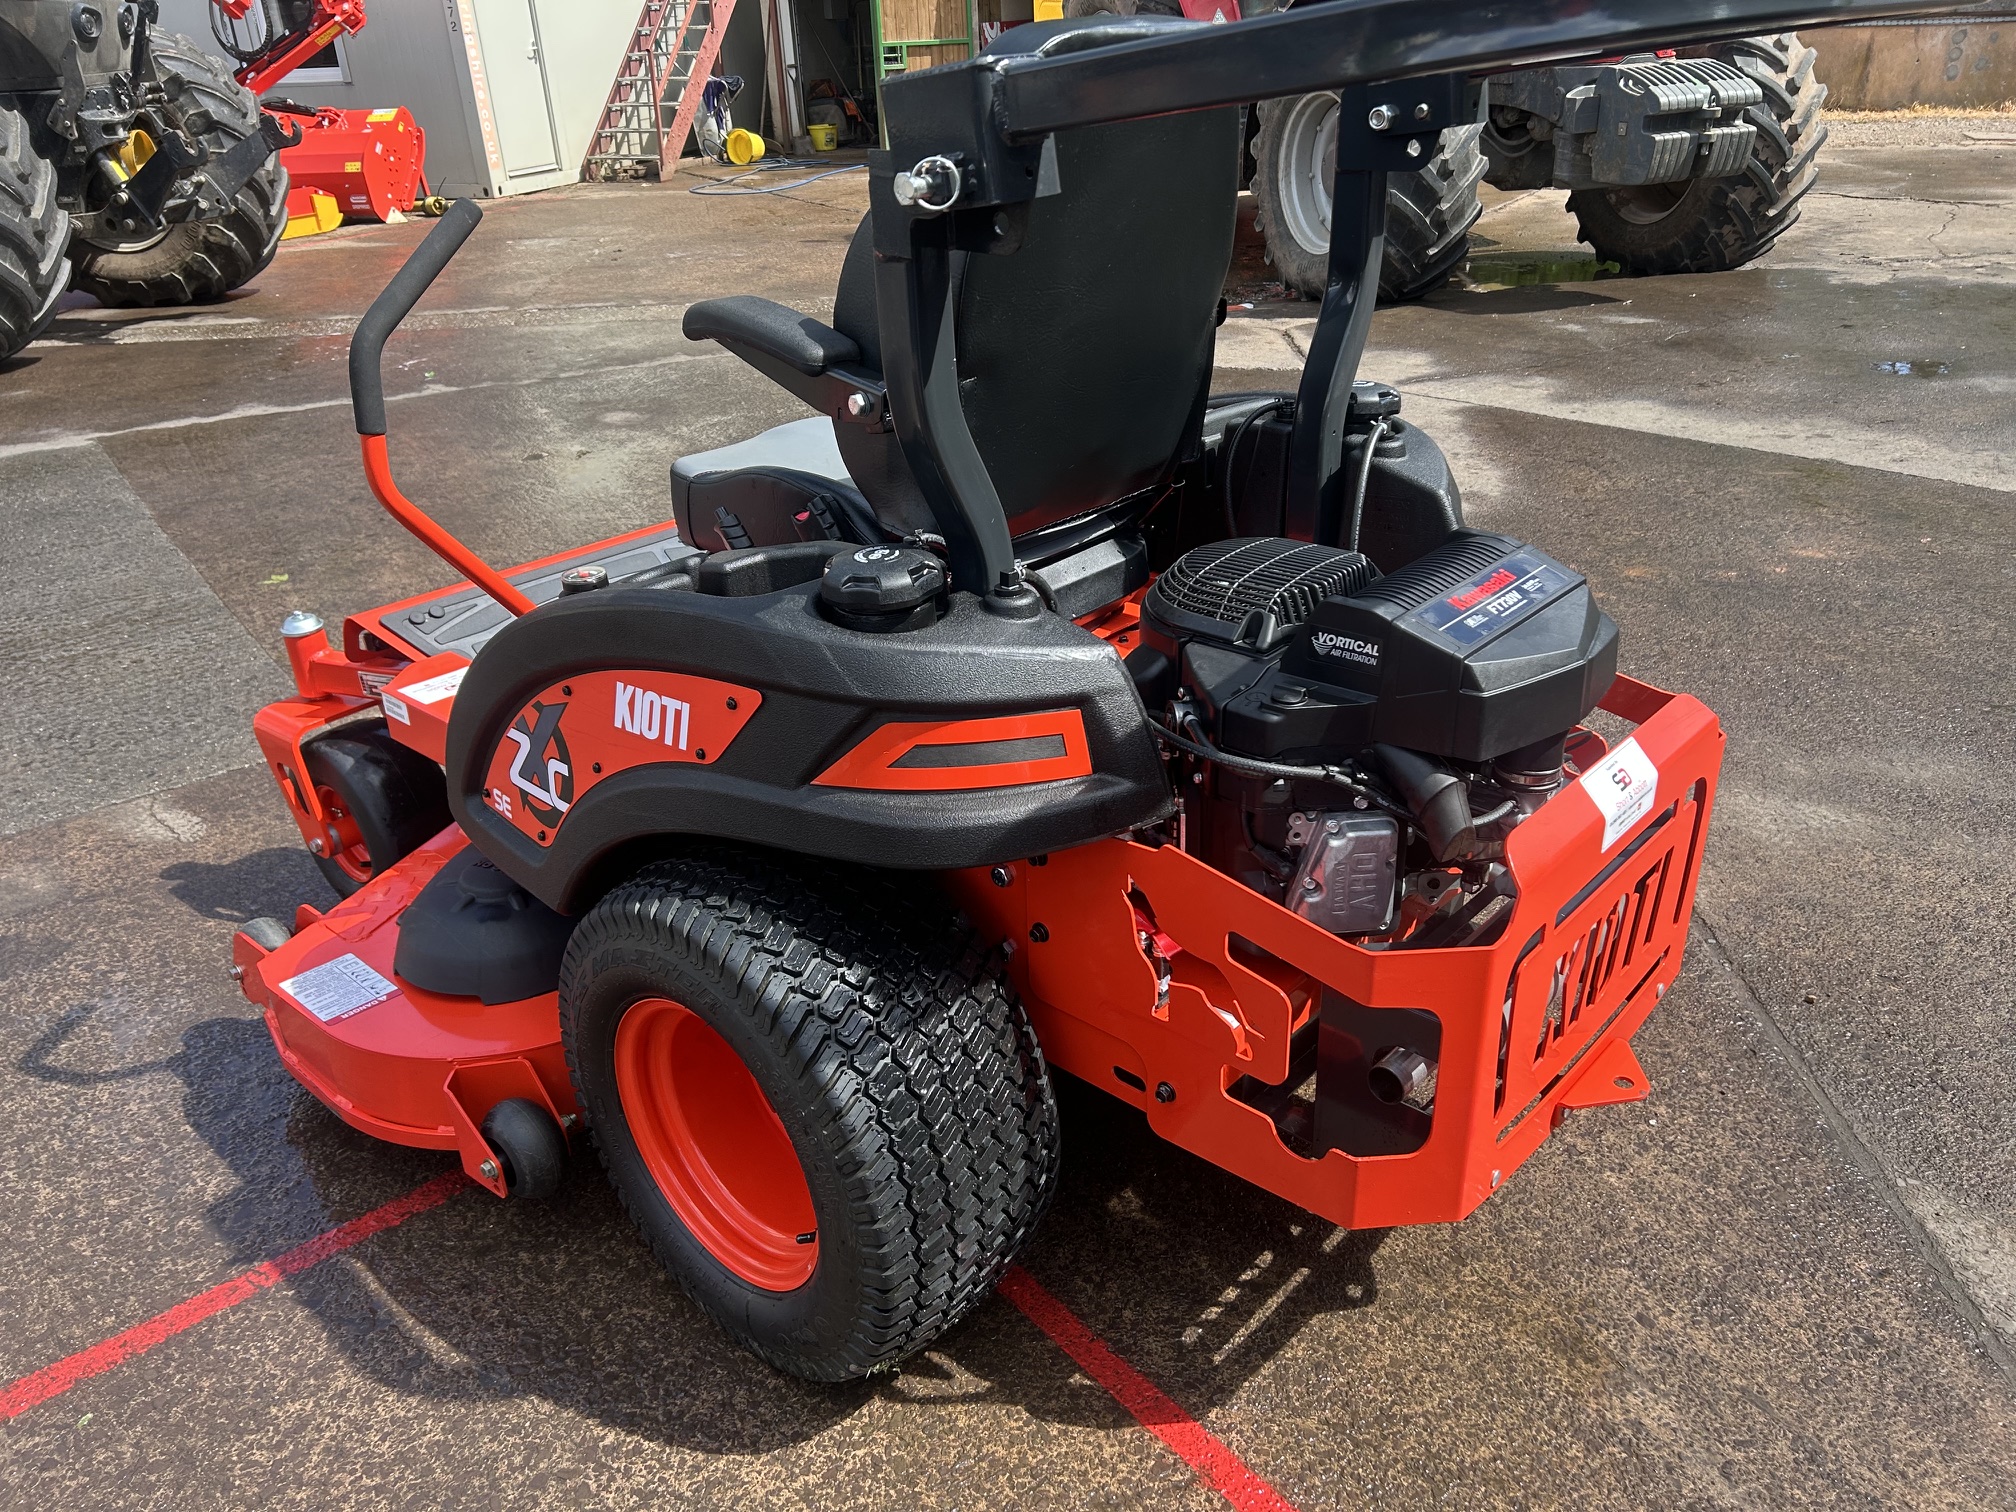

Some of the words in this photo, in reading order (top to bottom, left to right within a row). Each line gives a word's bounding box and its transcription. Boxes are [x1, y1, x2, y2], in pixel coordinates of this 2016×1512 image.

[1446, 567, 1518, 611] Kawasaki
[1486, 589, 1523, 616] FT730V
[1318, 631, 1380, 657] VORTICAL
[1329, 648, 1342, 658] AIR
[1341, 650, 1378, 666] FILTRATION
[614, 680, 691, 752] KIOTI
[492, 787, 513, 820] SE
[1349, 851, 1378, 911] OHV
[340, 1000, 379, 1019] DANGER
